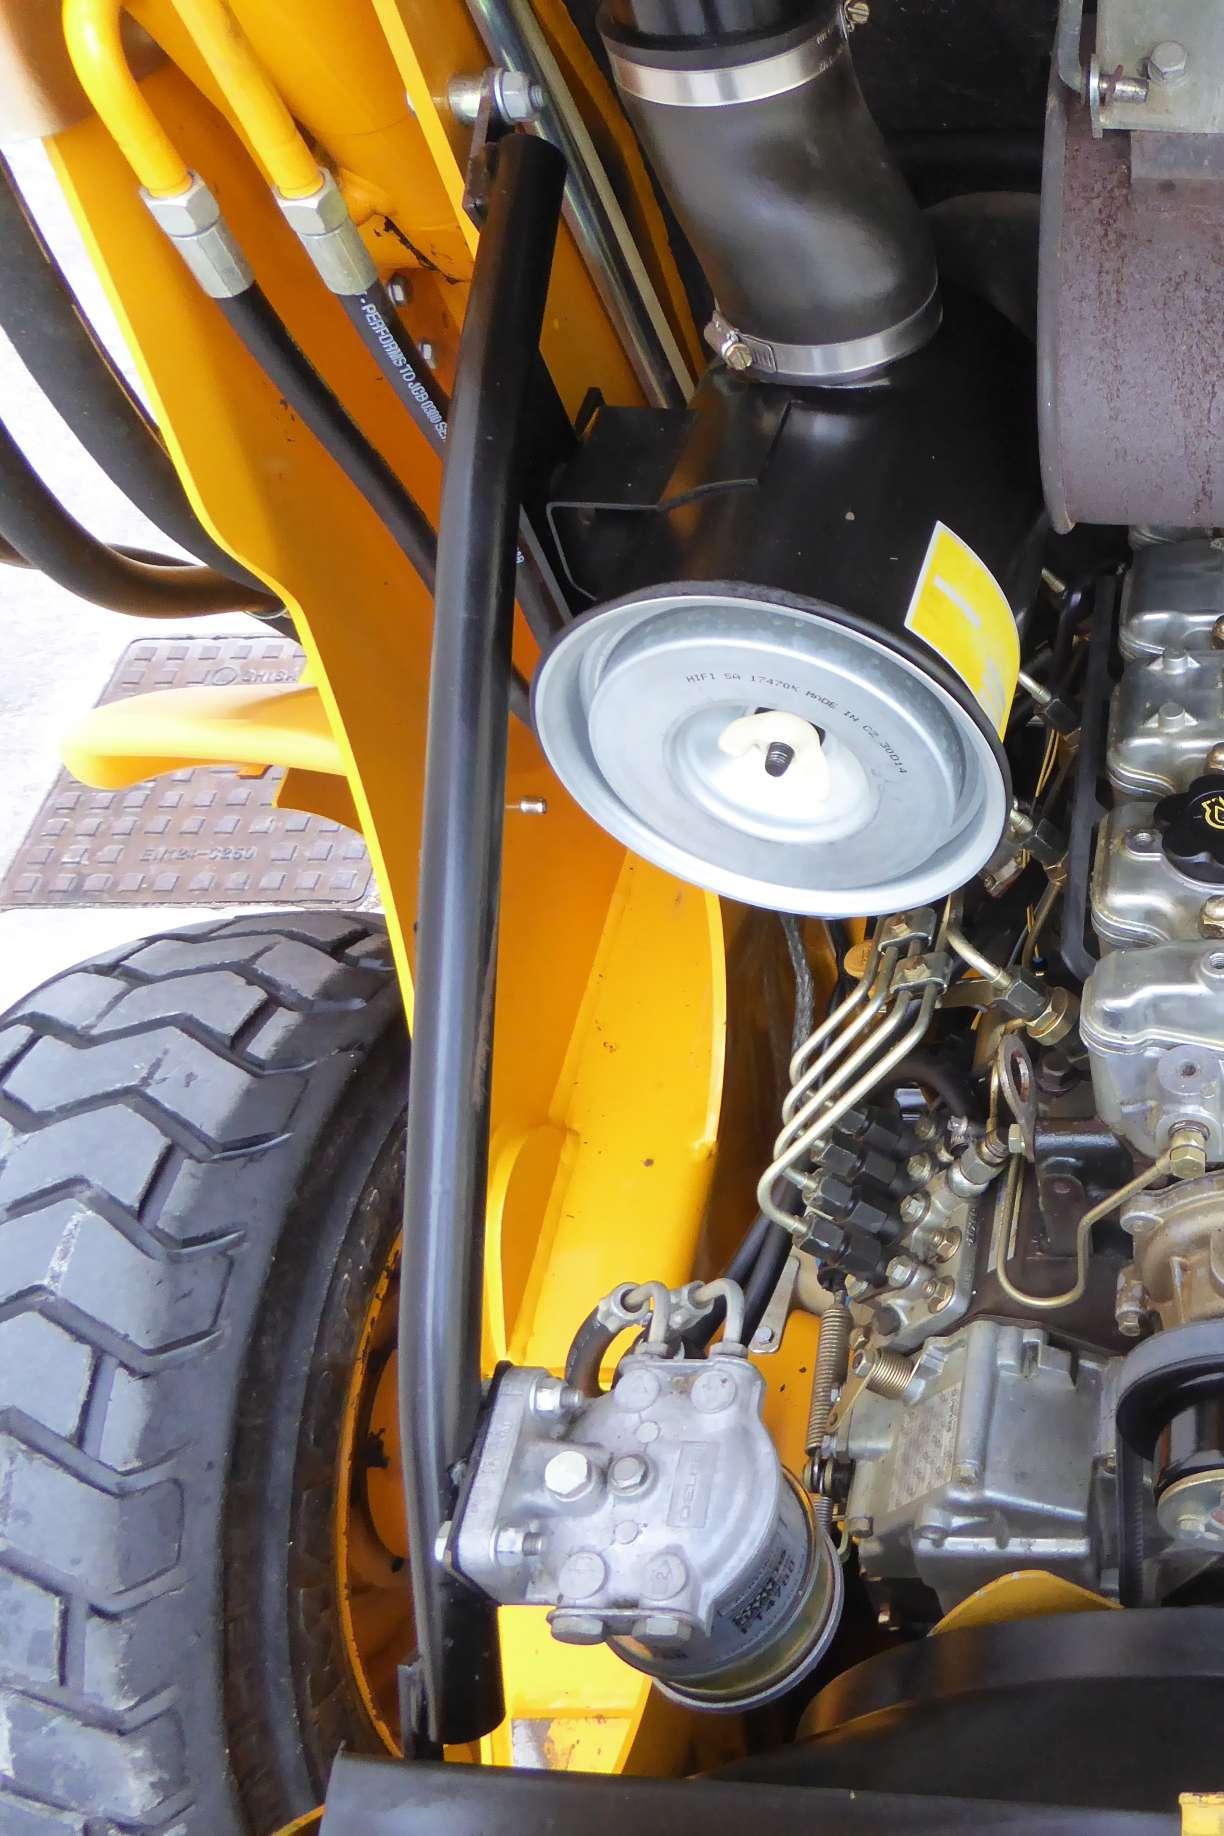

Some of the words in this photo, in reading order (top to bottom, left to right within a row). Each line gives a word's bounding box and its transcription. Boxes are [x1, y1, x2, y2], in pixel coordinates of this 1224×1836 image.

[362, 303, 407, 368] PERFORMS
[399, 363, 416, 382] TO
[408, 382, 429, 402] JCB
[805, 690, 839, 710] MADE
[843, 710, 860, 722] IN
